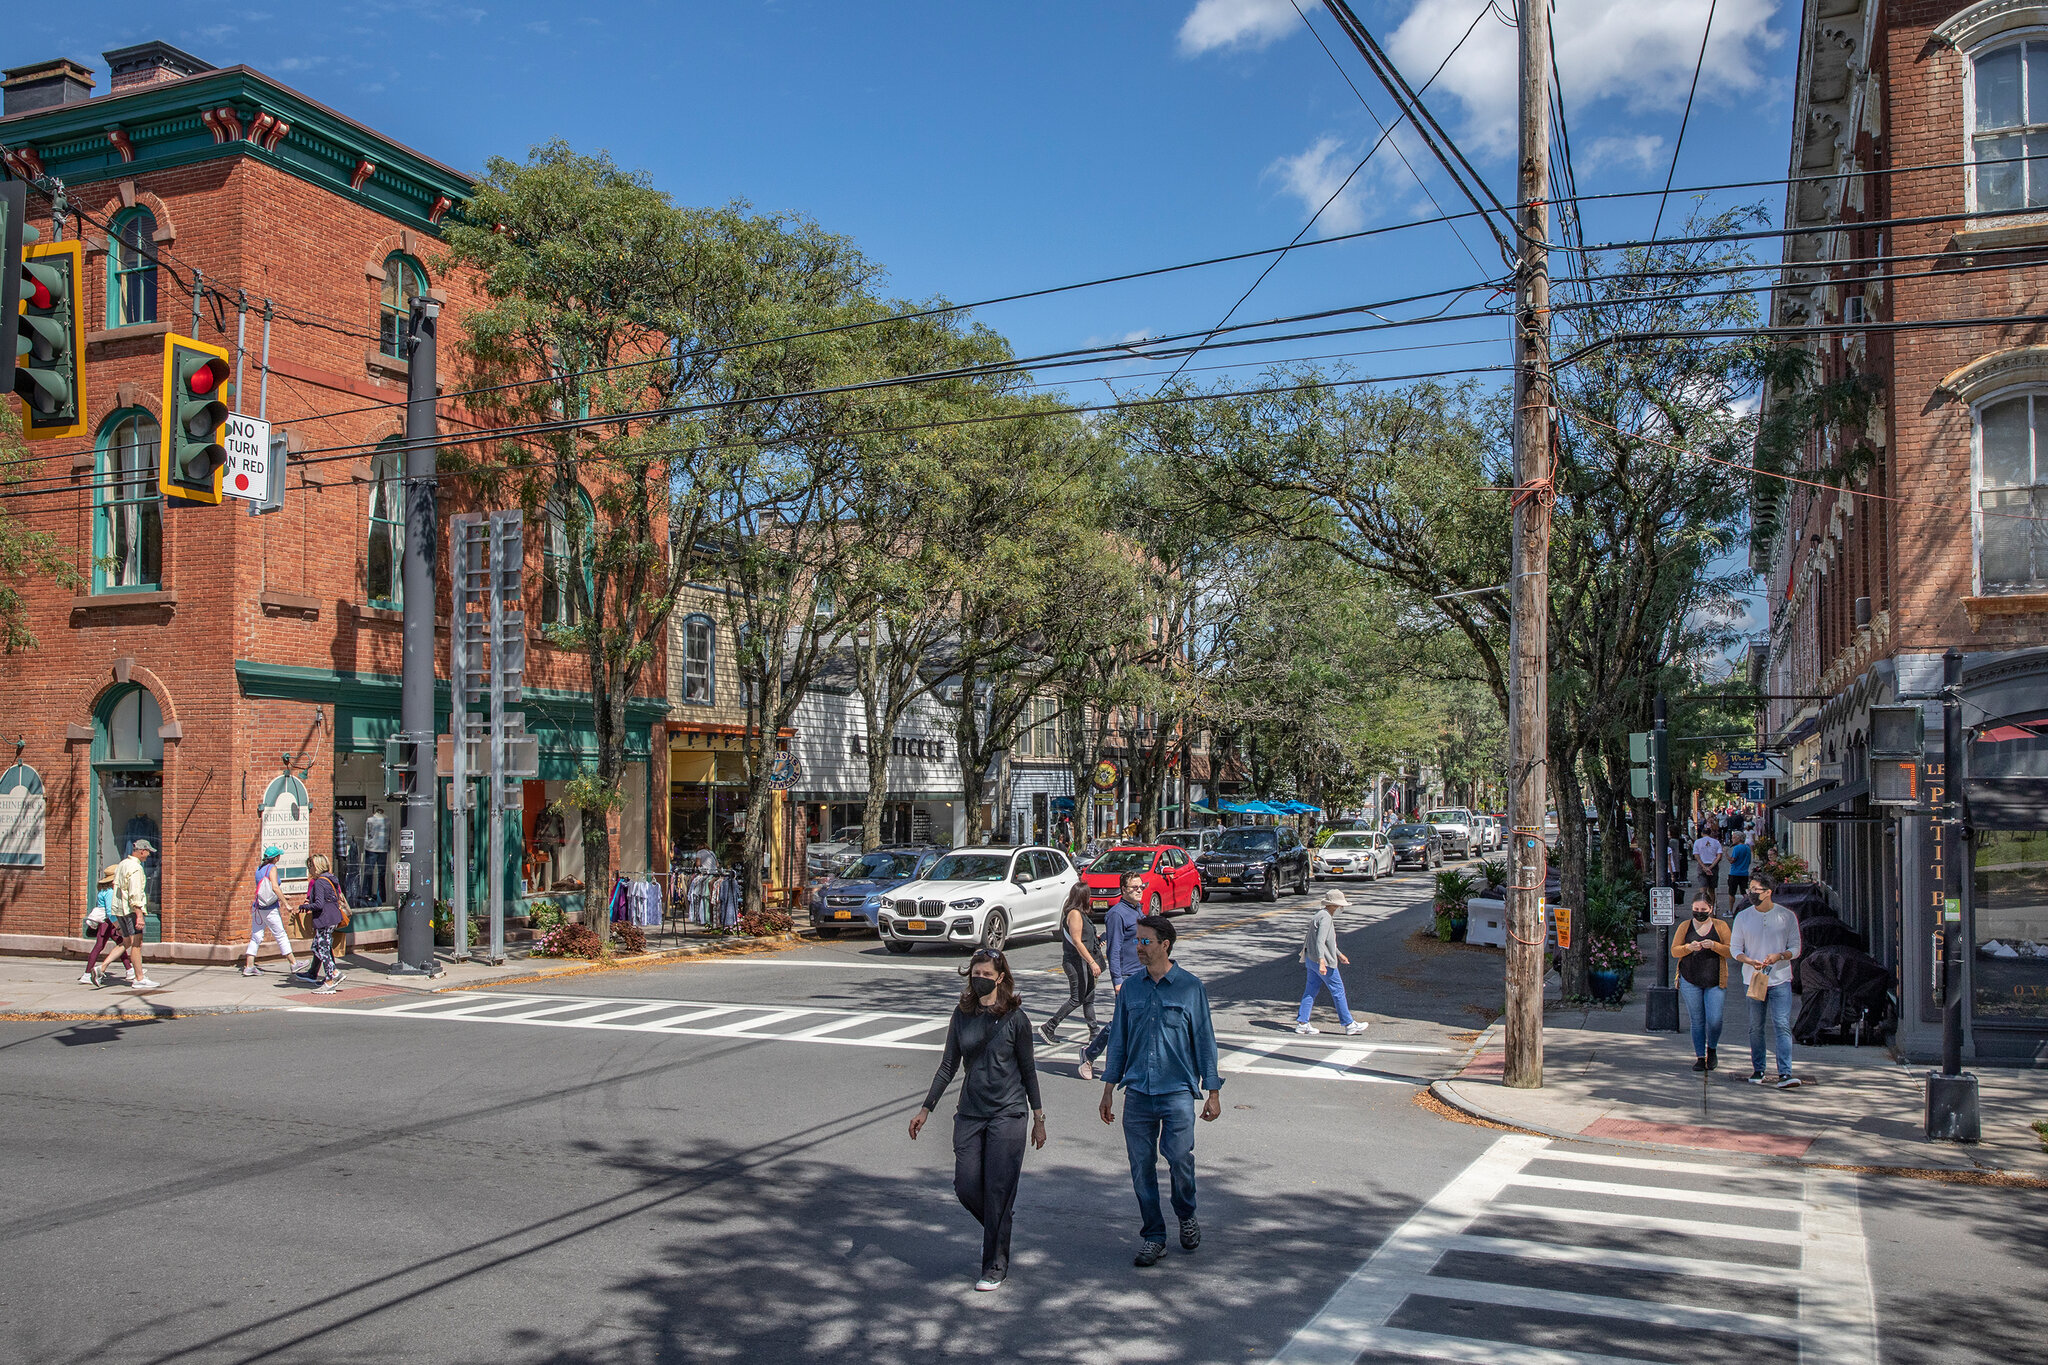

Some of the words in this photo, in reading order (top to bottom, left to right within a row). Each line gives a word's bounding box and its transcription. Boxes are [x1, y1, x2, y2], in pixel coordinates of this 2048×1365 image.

[233, 420, 255, 438] NO
[228, 439, 259, 456] TURN
[243, 459, 264, 474] RED
[892, 737, 944, 758] TICKLE
[775, 751, 799, 766] ASUS
[0, 801, 43, 809] HINEBECK
[263, 828, 308, 837] DEPARTMENT
